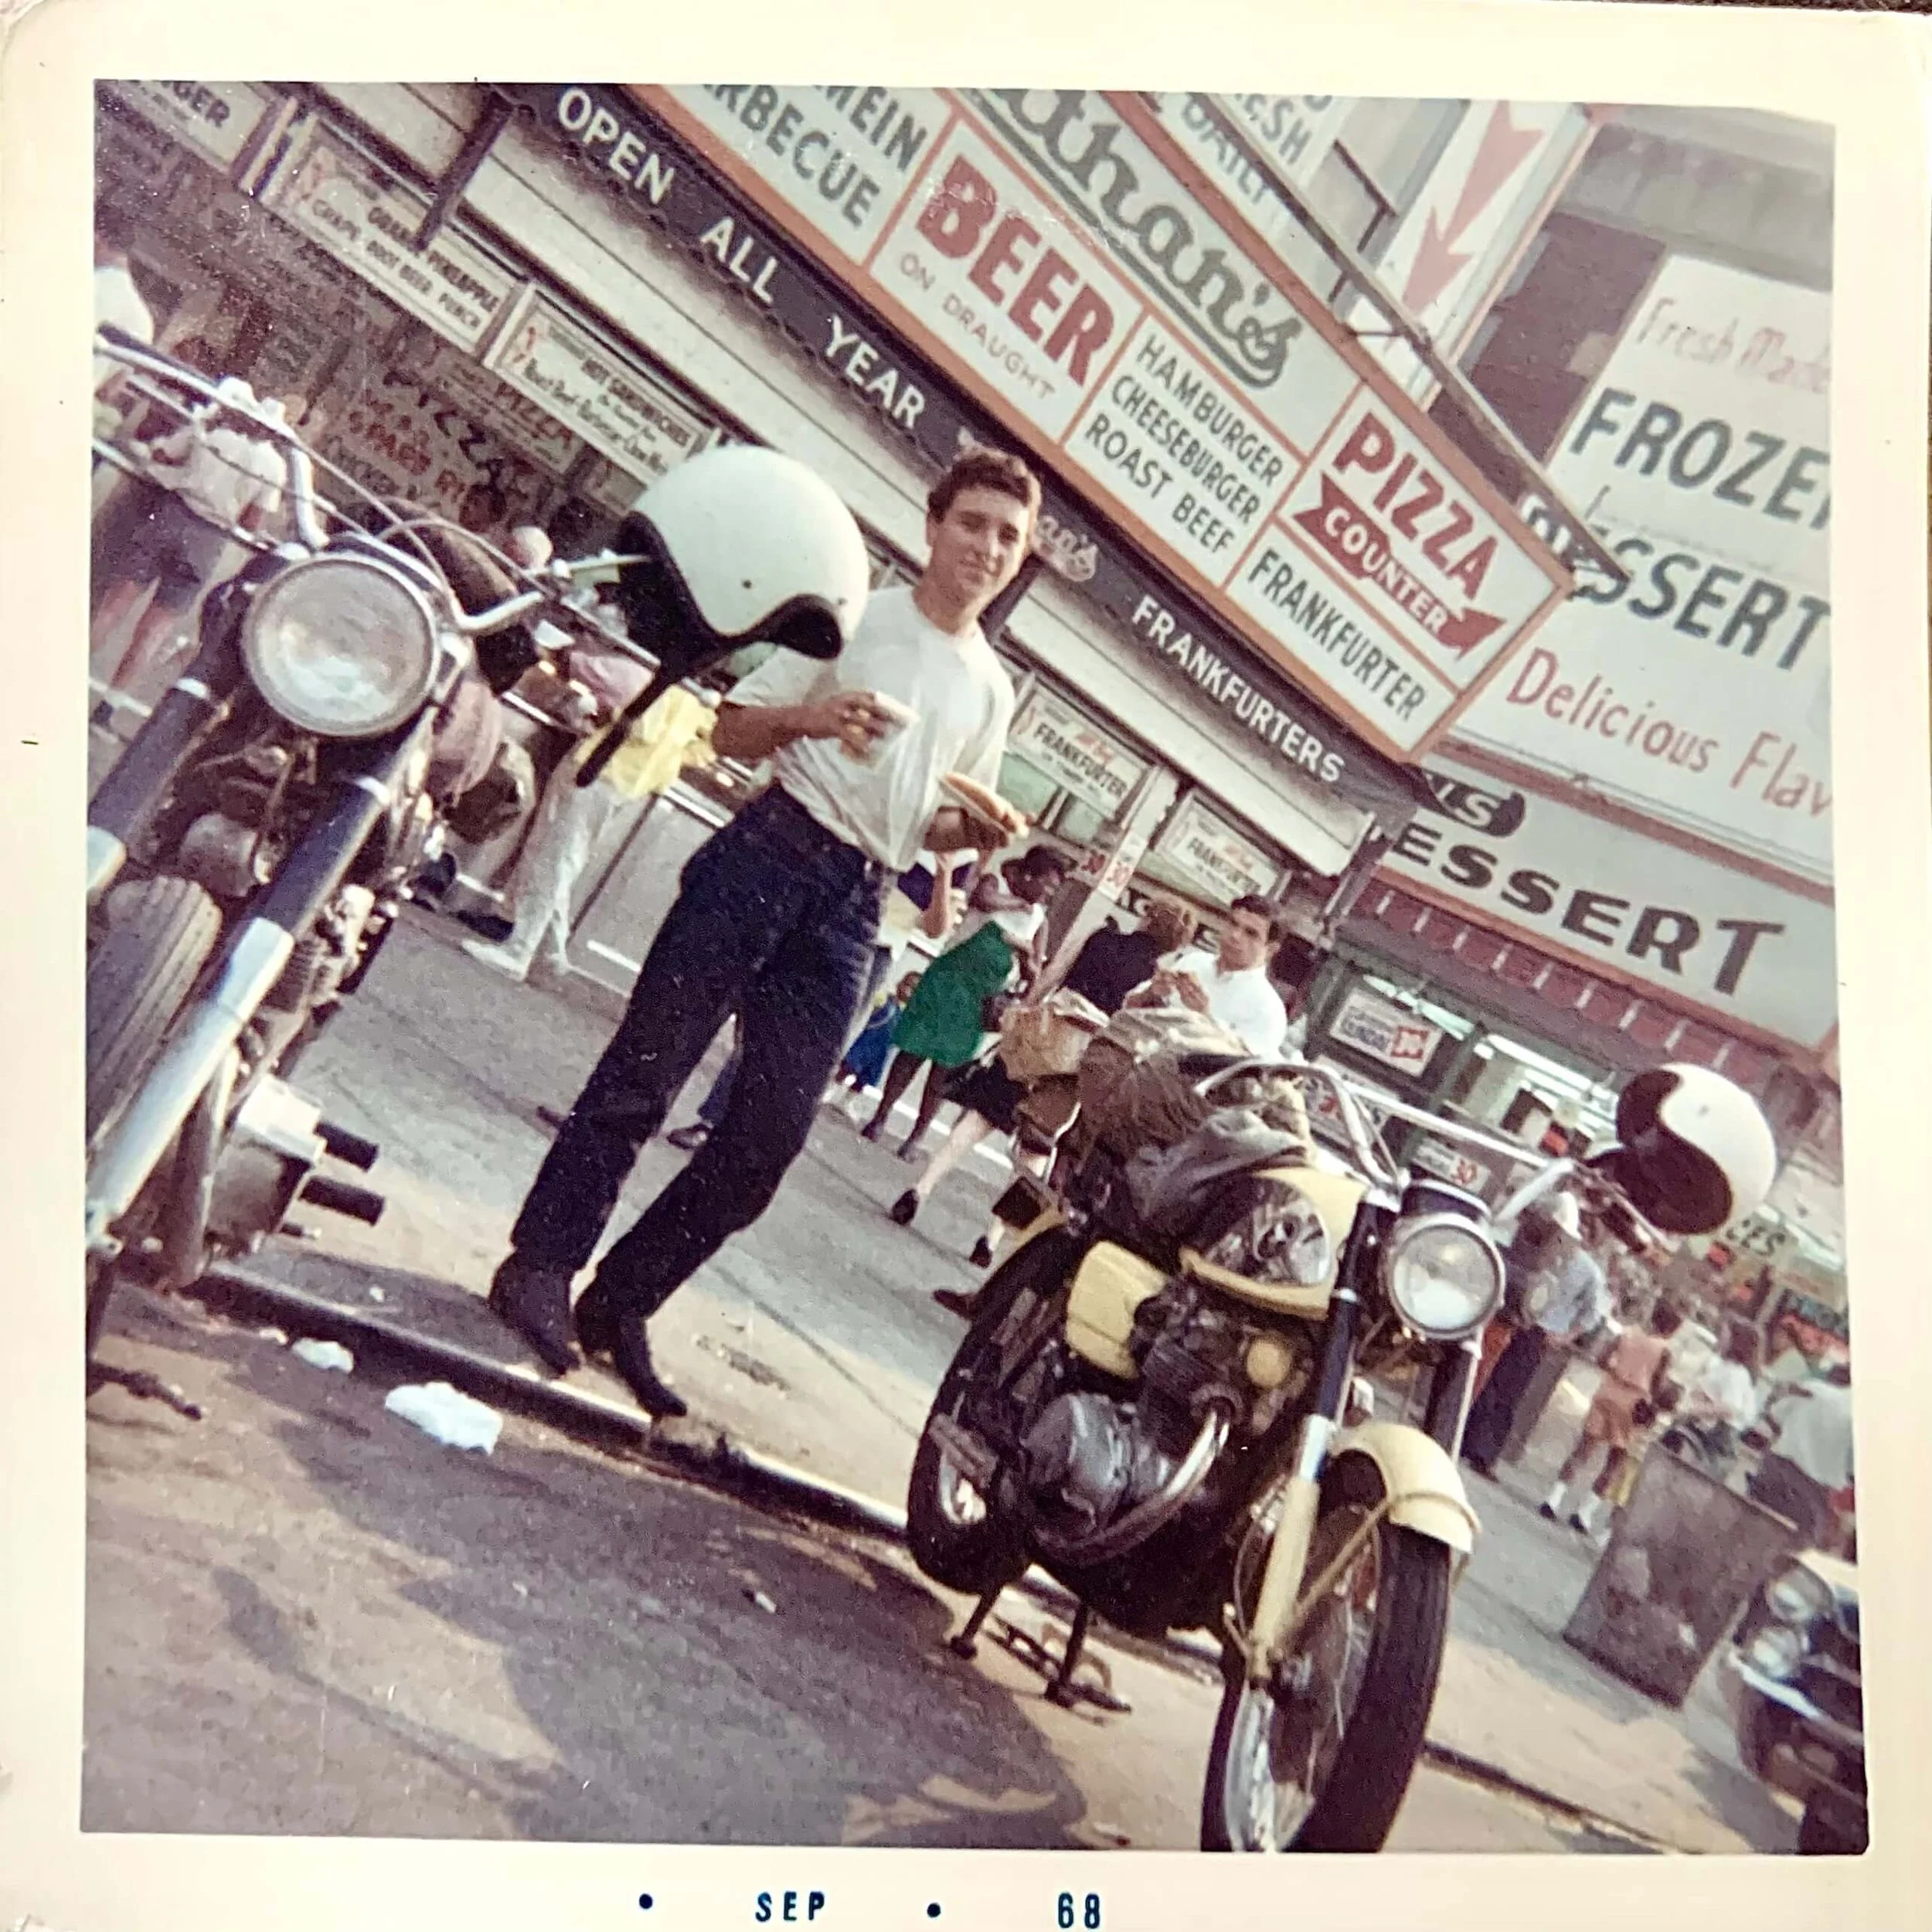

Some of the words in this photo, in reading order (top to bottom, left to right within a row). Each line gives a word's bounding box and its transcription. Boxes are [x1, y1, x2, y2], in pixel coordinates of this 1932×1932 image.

[557, 89, 675, 205] OPEN
[699, 216, 780, 304] ALL
[824, 314, 927, 429] YEAR
[899, 252, 937, 292] ON
[942, 293, 1056, 401] DRAUGHT
[915, 154, 1115, 387] BEER
[1085, 413, 1174, 499] ROAST
[1171, 494, 1236, 555] BEEF
[1111, 375, 1261, 525] CHEESEBURGER
[1136, 334, 1284, 488] HAMBURGER
[1324, 506, 1448, 633] COUNTER
[1332, 411, 1498, 600] PIZZA
[1132, 595, 1346, 783] FRANKFURTERS
[1247, 549, 1427, 723] FRANKFURTER
[1505, 648, 1721, 774] Delicious
[1033, 723, 1128, 801] FRANKFURTER
[1392, 821, 1786, 996] ESSERT
